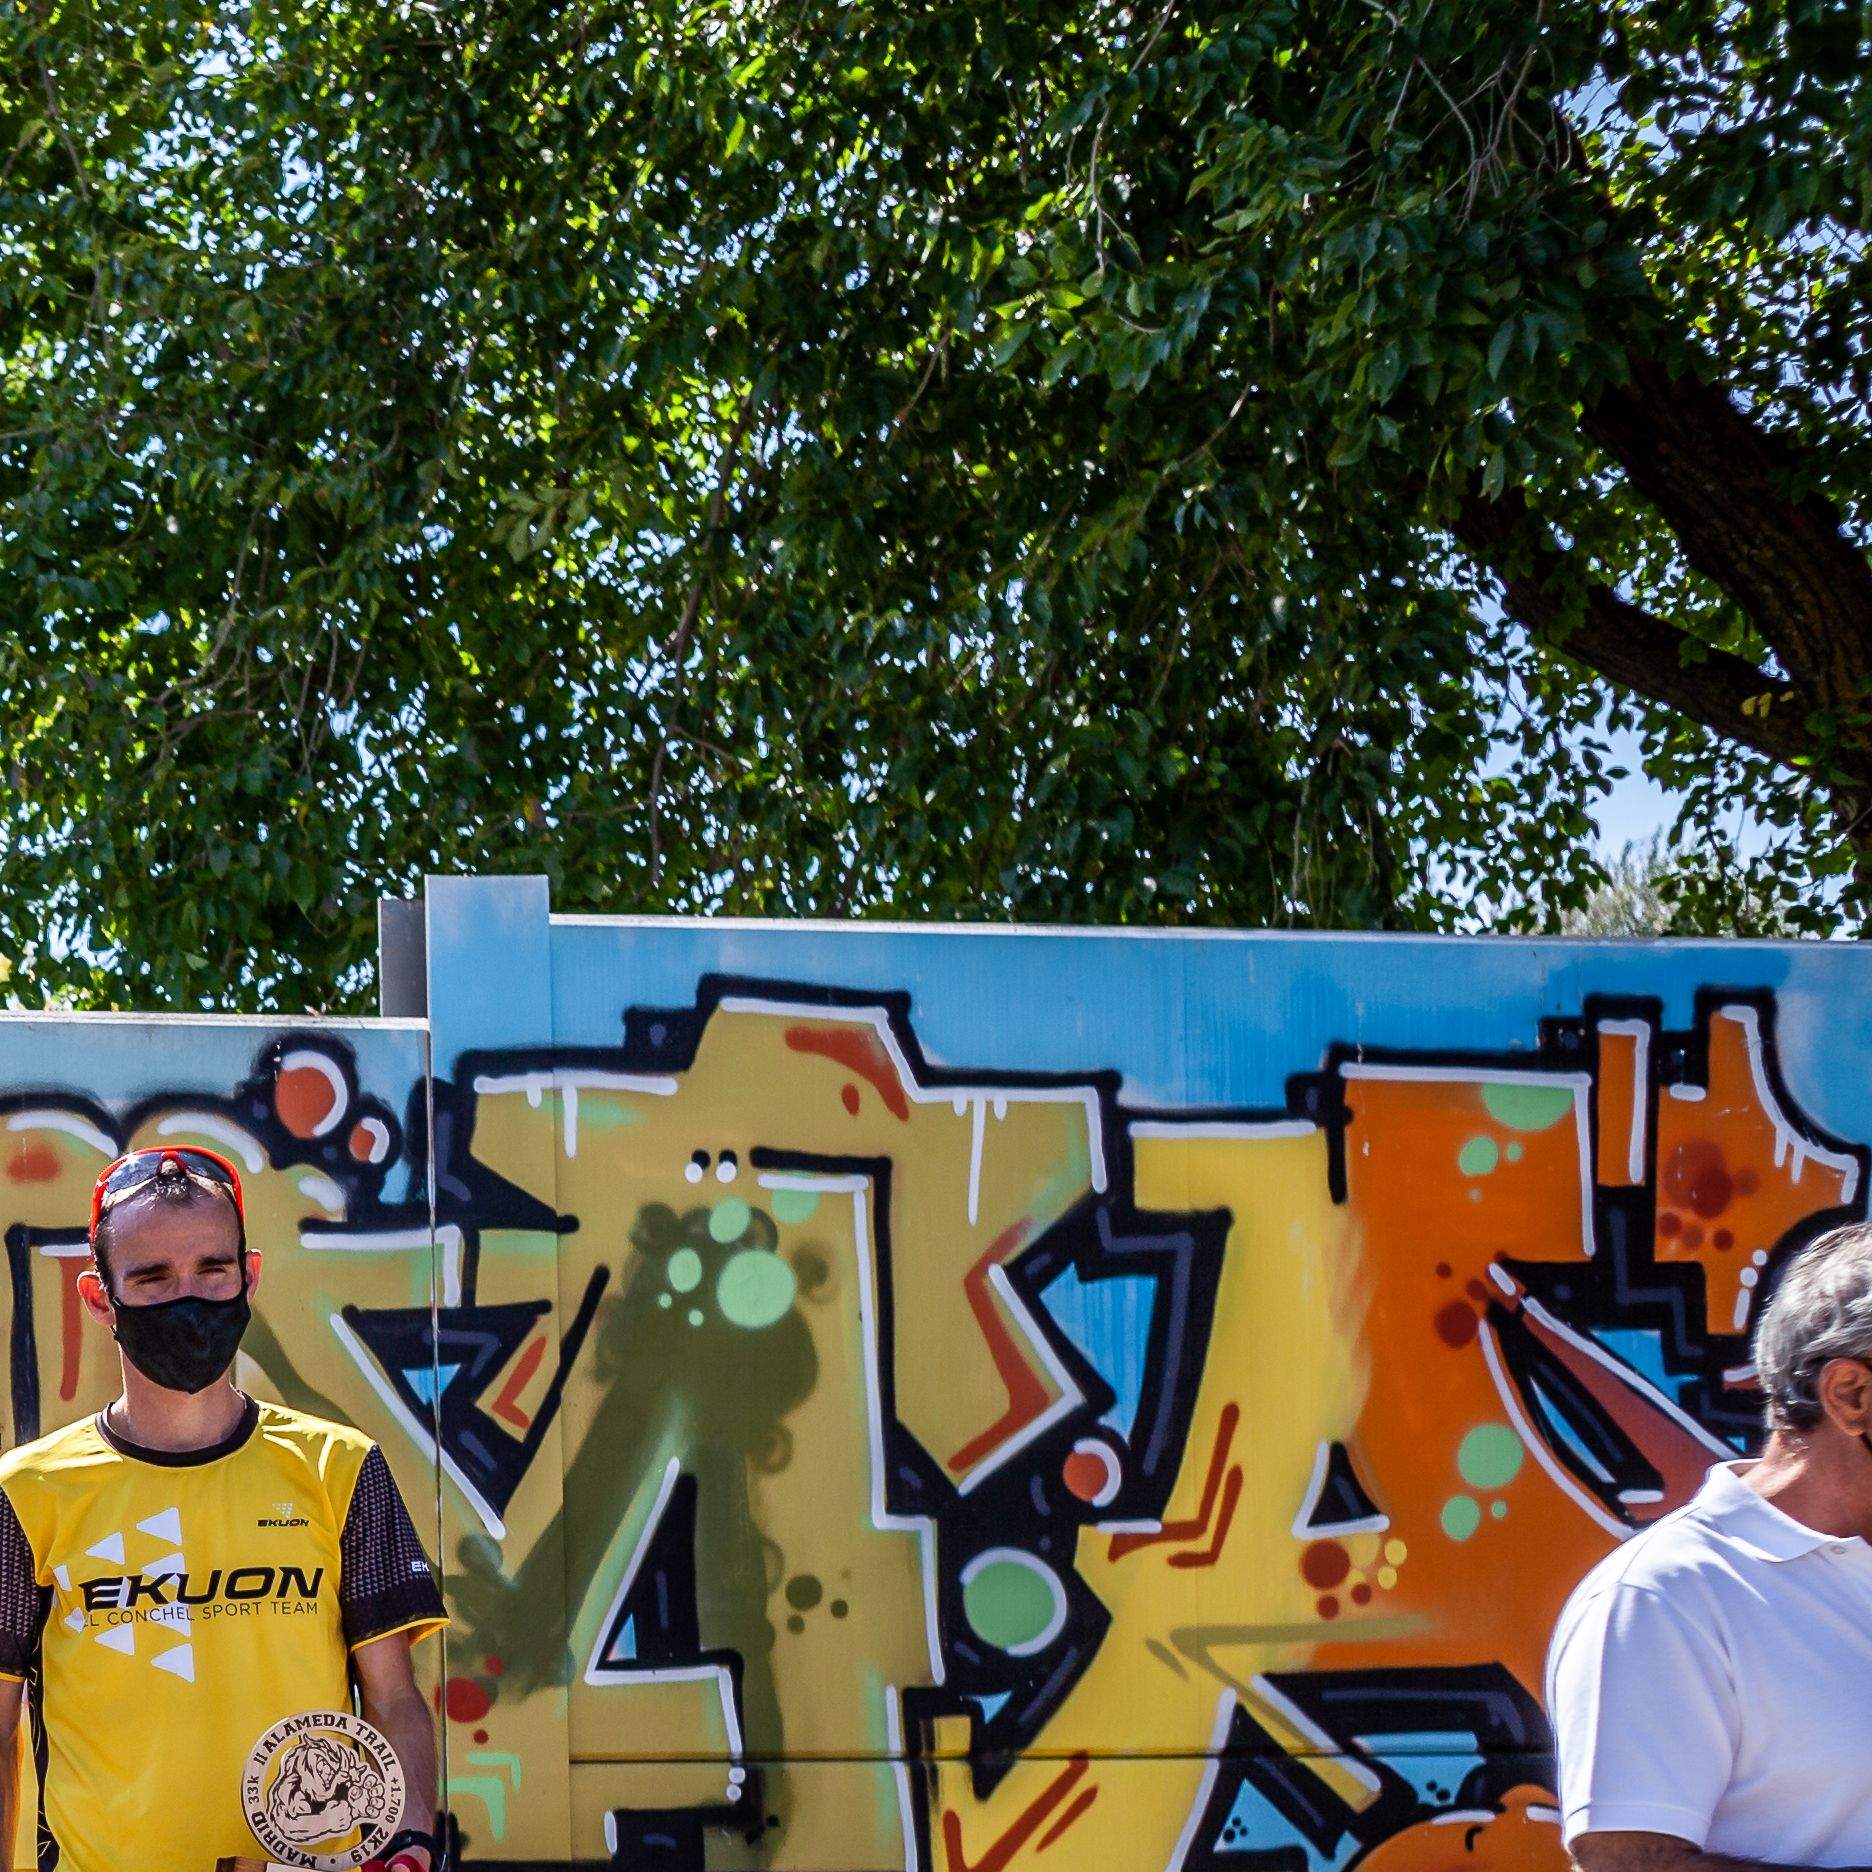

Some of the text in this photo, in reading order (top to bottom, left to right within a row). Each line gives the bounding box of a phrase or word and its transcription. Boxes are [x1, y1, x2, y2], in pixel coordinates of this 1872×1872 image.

[78, 1567, 324, 1612] EKUON
[106, 1601, 319, 1626] CONCHEL SPORT TEAM
[262, 1713, 348, 1754] ALAMEDA
[355, 1722, 396, 1772] TRAIL
[250, 1811, 317, 1869] MADRID
